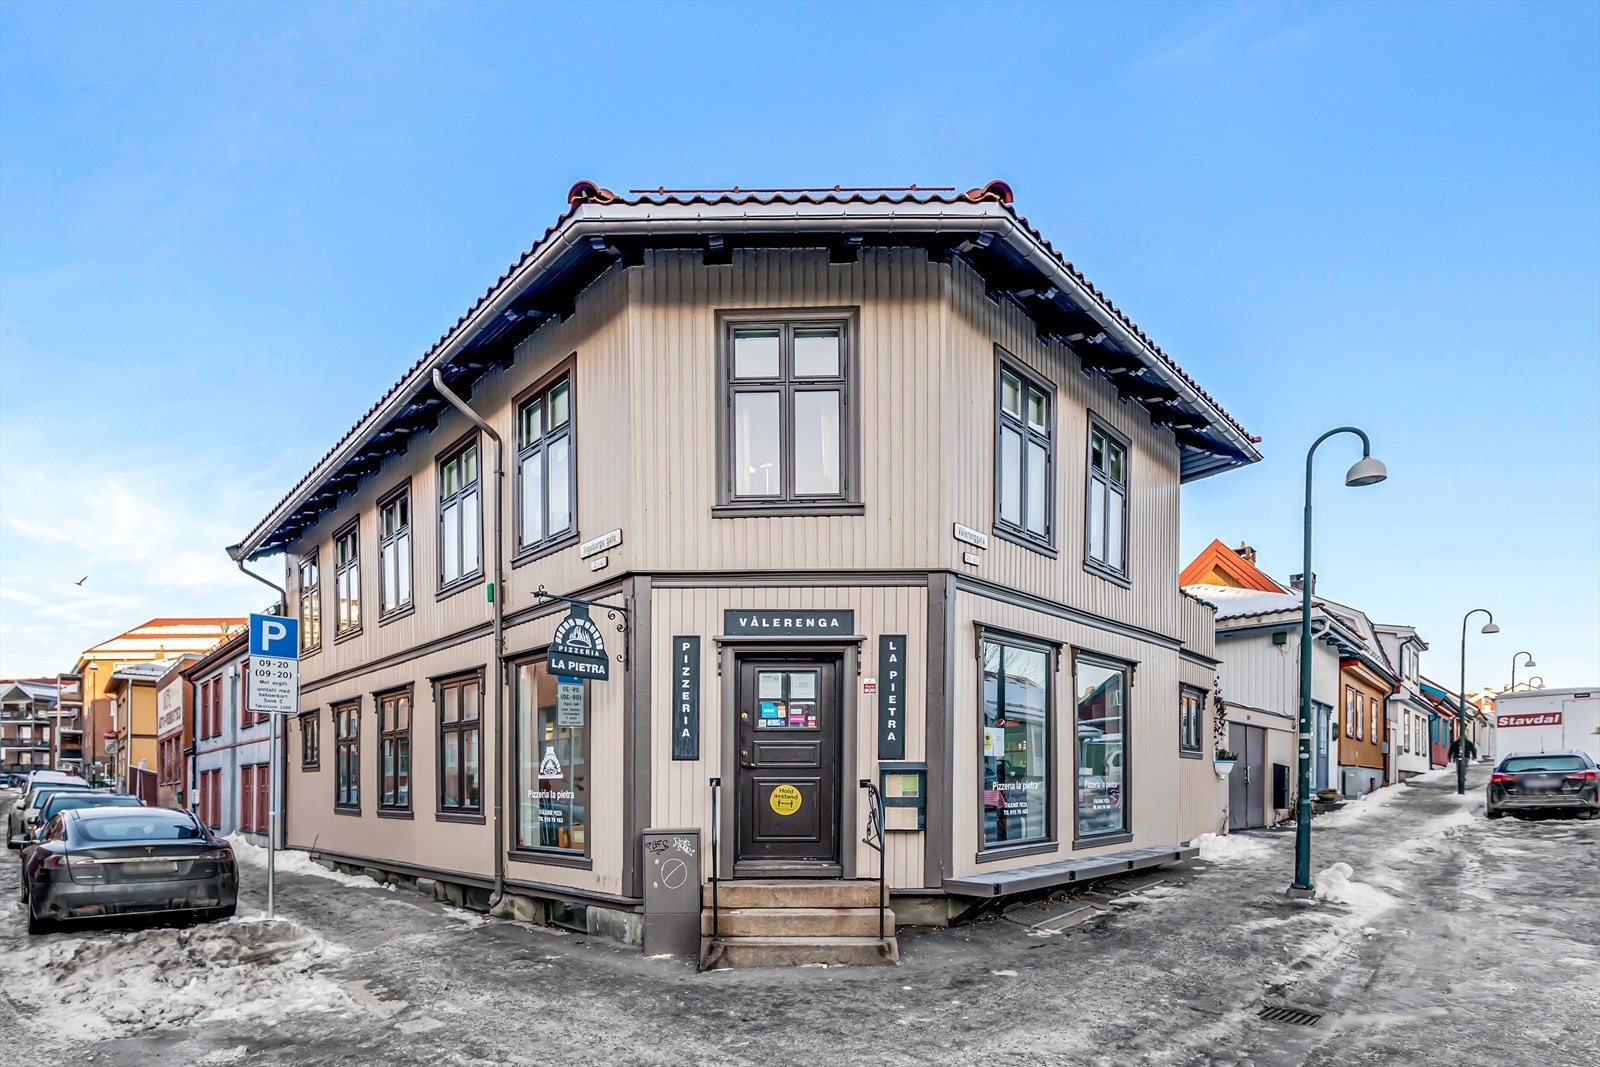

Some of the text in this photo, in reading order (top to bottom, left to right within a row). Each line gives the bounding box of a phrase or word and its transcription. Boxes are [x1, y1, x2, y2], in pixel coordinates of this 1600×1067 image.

[739, 616, 839, 627] VÅLERENGA
[262, 620, 287, 651] P
[558, 645, 600, 657] PIZZERIA
[551, 658, 606, 674] LA PIETRA
[682, 642, 690, 738] PIZZERIA
[887, 641, 898, 741] LA PIETRA
[1498, 714, 1560, 726] Stavdal
[992, 780, 1038, 791] Pizzeria la pietra
[527, 789, 575, 801] Pizzeria la pietra
